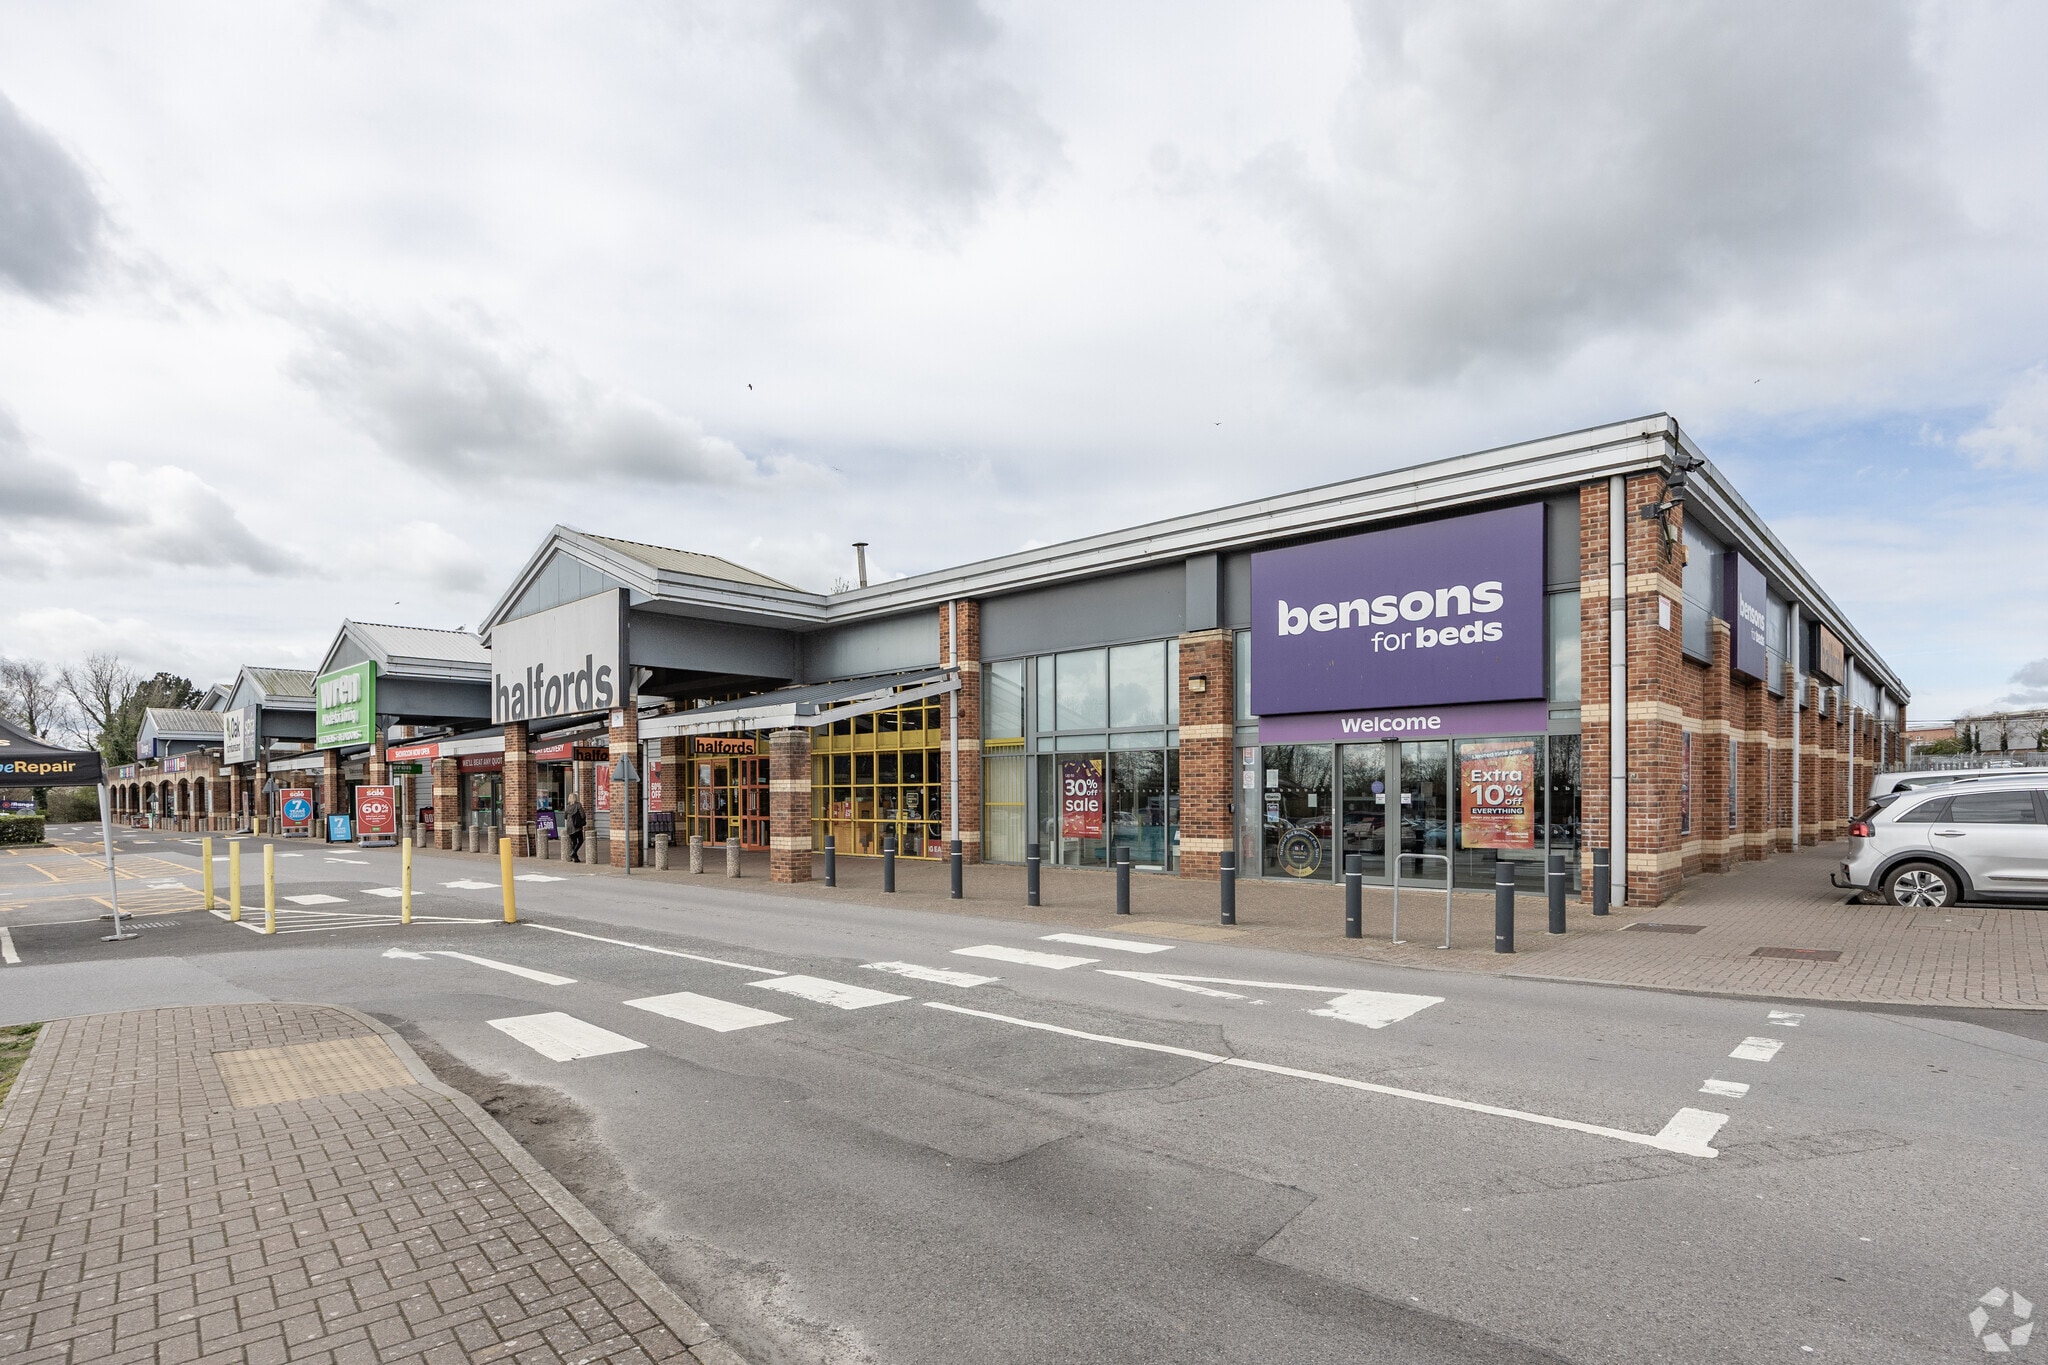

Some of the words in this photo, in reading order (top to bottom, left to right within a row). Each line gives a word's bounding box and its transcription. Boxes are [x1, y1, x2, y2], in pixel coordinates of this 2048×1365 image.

[1278, 581, 1504, 636] bensons
[1740, 592, 1765, 631] bensons
[1371, 631, 1411, 652] for
[1416, 620, 1503, 648] beds
[321, 673, 361, 709] wren
[495, 653, 613, 722] halfords
[1341, 716, 1441, 733] Welcome
[696, 740, 754, 755] halfords
[1471, 769, 1523, 782] Extra
[1065, 779, 1098, 796] 30%
[1470, 784, 1523, 806] 10%
[1065, 798, 1099, 812] sale
[1505, 798, 1524, 806] off
